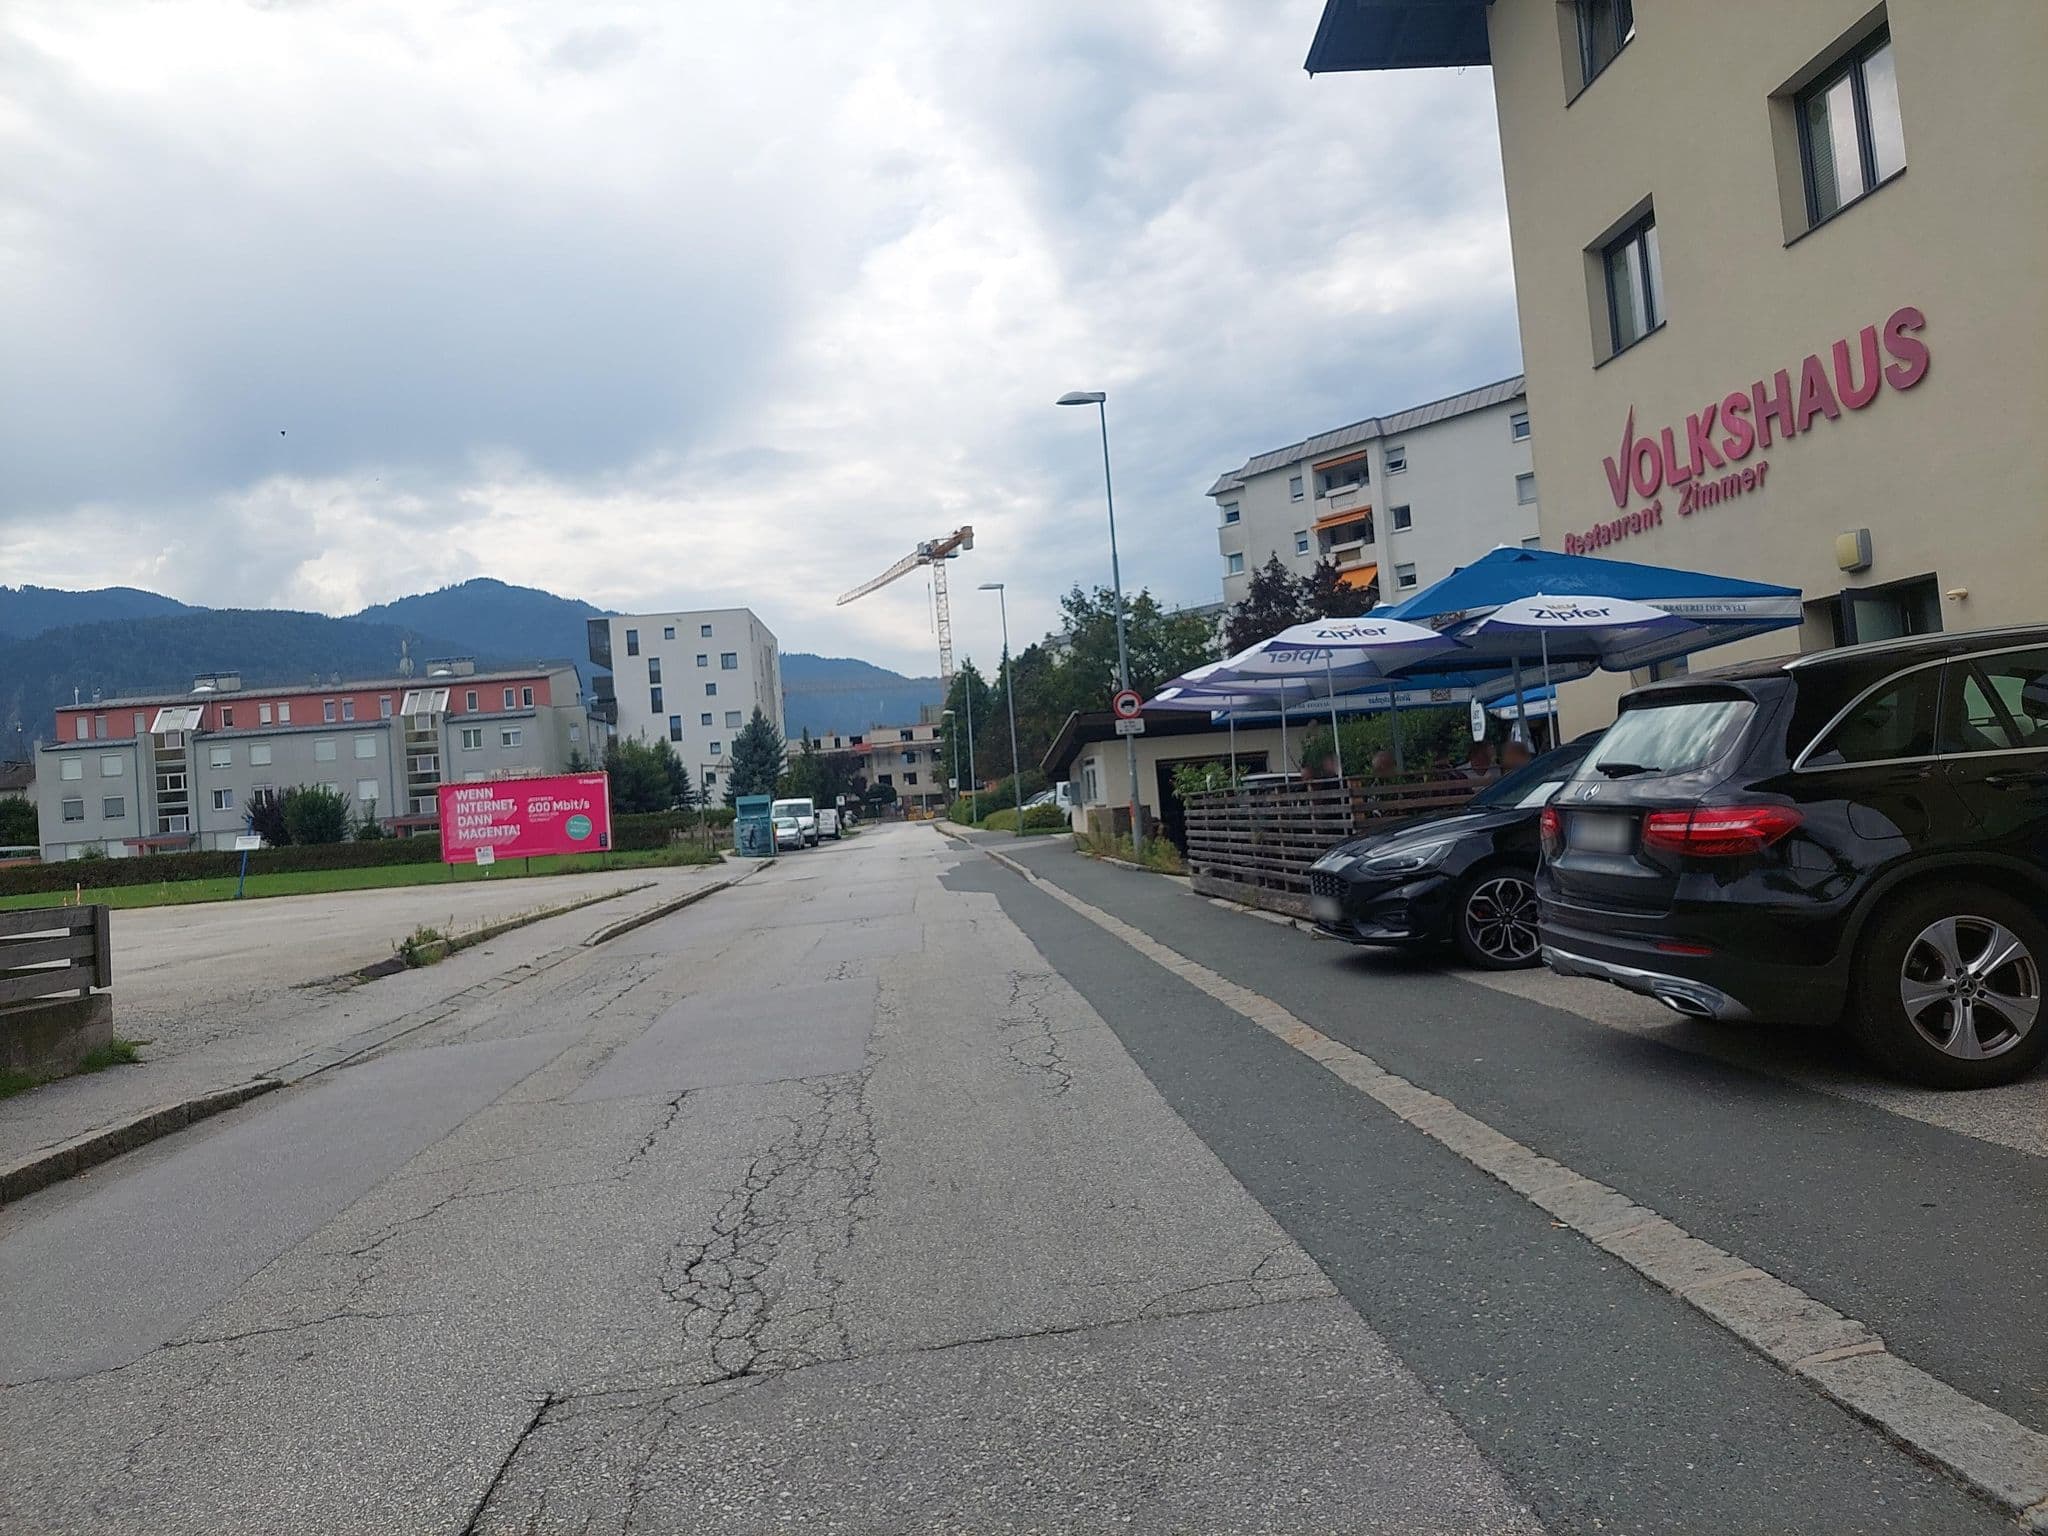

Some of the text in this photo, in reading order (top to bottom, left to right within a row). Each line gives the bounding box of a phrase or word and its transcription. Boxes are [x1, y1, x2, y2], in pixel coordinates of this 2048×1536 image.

[1602, 306, 1931, 507] VOLKSHAUS
[1564, 460, 1769, 555] Restaurant Zimmer
[1529, 606, 1610, 622] Zipfer
[1314, 625, 1387, 641] Zipfer
[456, 787, 493, 802] WENN
[457, 799, 518, 814] INTERNET,
[528, 802, 551, 812] 600
[553, 798, 590, 811] Mbit/s
[458, 814, 493, 827] DANN
[459, 824, 521, 841] MAGENTA!
